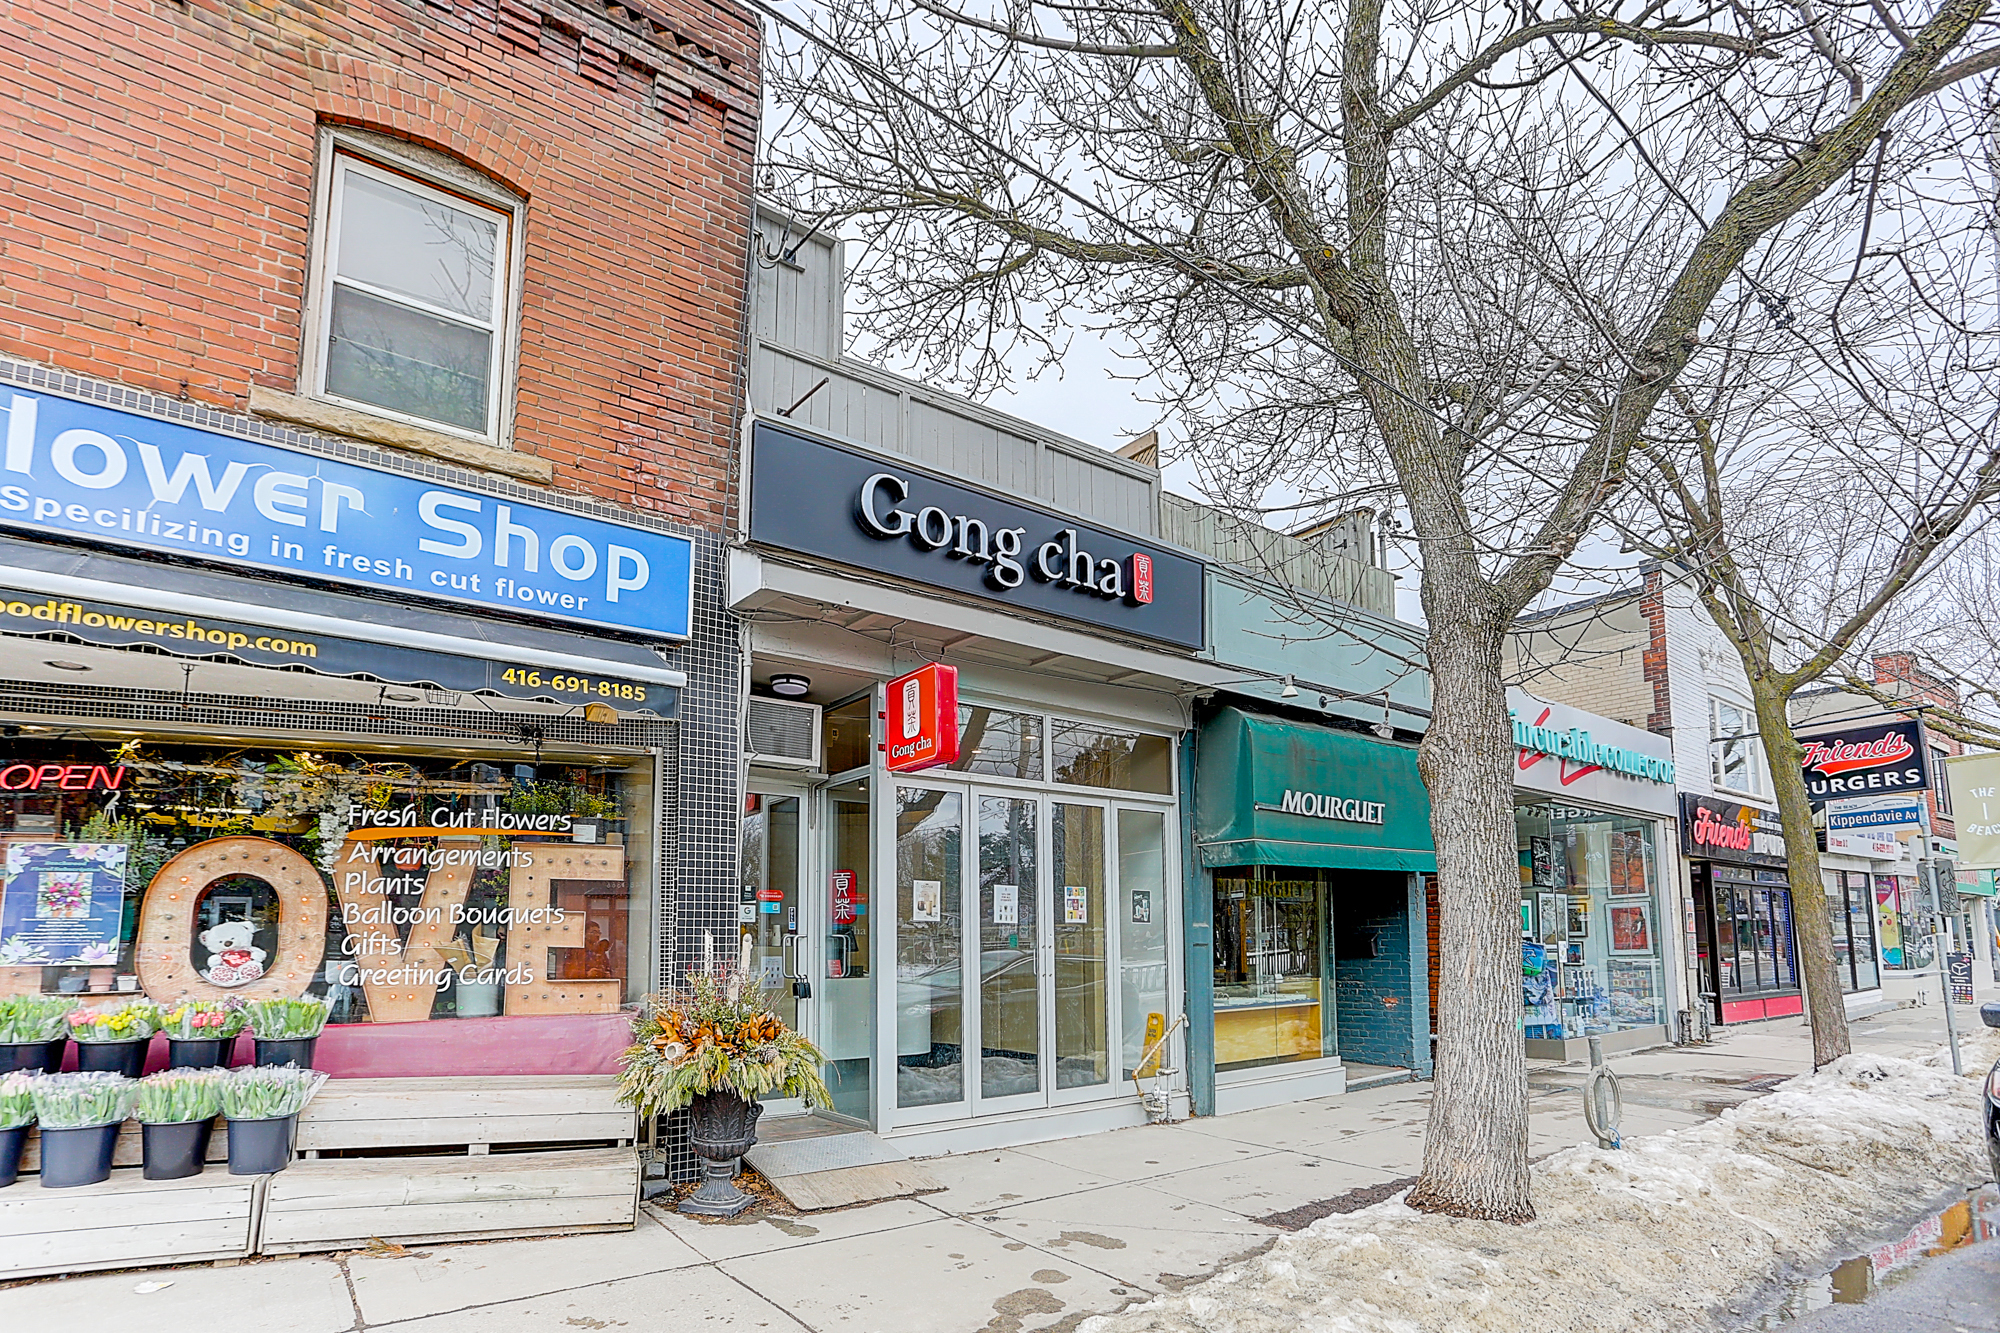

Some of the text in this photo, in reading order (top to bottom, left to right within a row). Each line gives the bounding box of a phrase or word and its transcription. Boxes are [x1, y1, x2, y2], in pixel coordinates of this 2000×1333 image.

[0, 392, 650, 602] lower Shop
[0, 485, 589, 611] Specilizing in fresh cut flower
[857, 472, 1127, 598] Gong cha
[0, 599, 318, 658] odflowershop.com
[501, 667, 647, 702] 416-691-8185
[891, 736, 932, 758] Gong cha
[1801, 731, 1907, 768] Friends
[0, 764, 126, 790] OPEN
[1969, 787, 1996, 798] THE
[347, 803, 572, 832] Fresh Cut Flowers
[1280, 789, 1386, 825] MOURGUET
[1829, 810, 1917, 828] Kippendavie Av
[1693, 806, 1751, 851] Friends
[346, 841, 534, 873] Arrangements
[1752, 832, 1787, 858] BUR
[344, 870, 426, 896] Plants
[832, 872, 852, 920] 貢茶
[342, 900, 566, 931] Balloon Bouquets
[340, 930, 402, 955] Gifts
[338, 962, 534, 992] Greeting Cards
